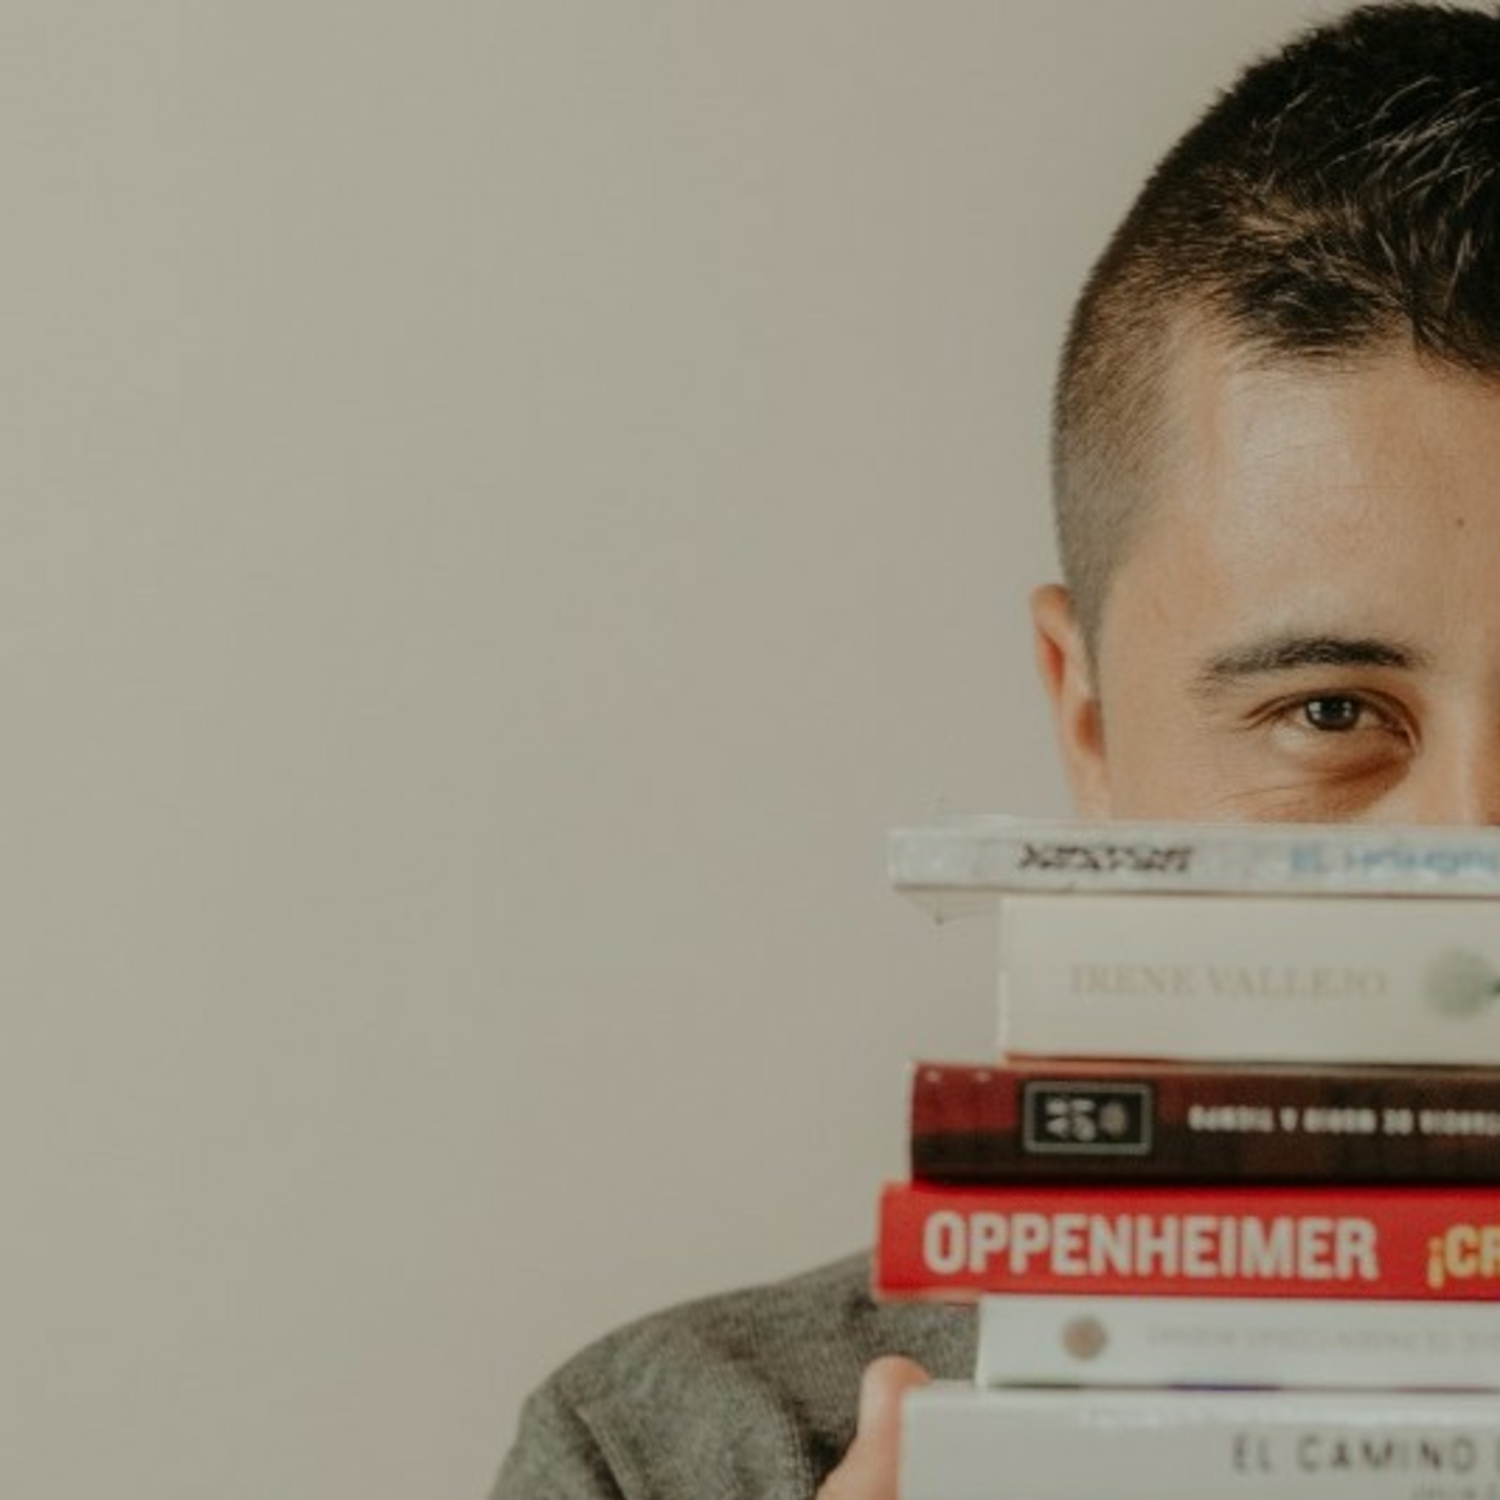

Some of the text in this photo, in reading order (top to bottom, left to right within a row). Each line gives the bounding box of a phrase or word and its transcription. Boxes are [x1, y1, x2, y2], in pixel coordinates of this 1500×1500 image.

[1070, 966, 1389, 1000] IRENE VALLEJO
[922, 1210, 1379, 1281] OPPENHEIMER
[1232, 1436, 1273, 1472] EL
[1298, 1436, 1476, 1473] CAMINO
